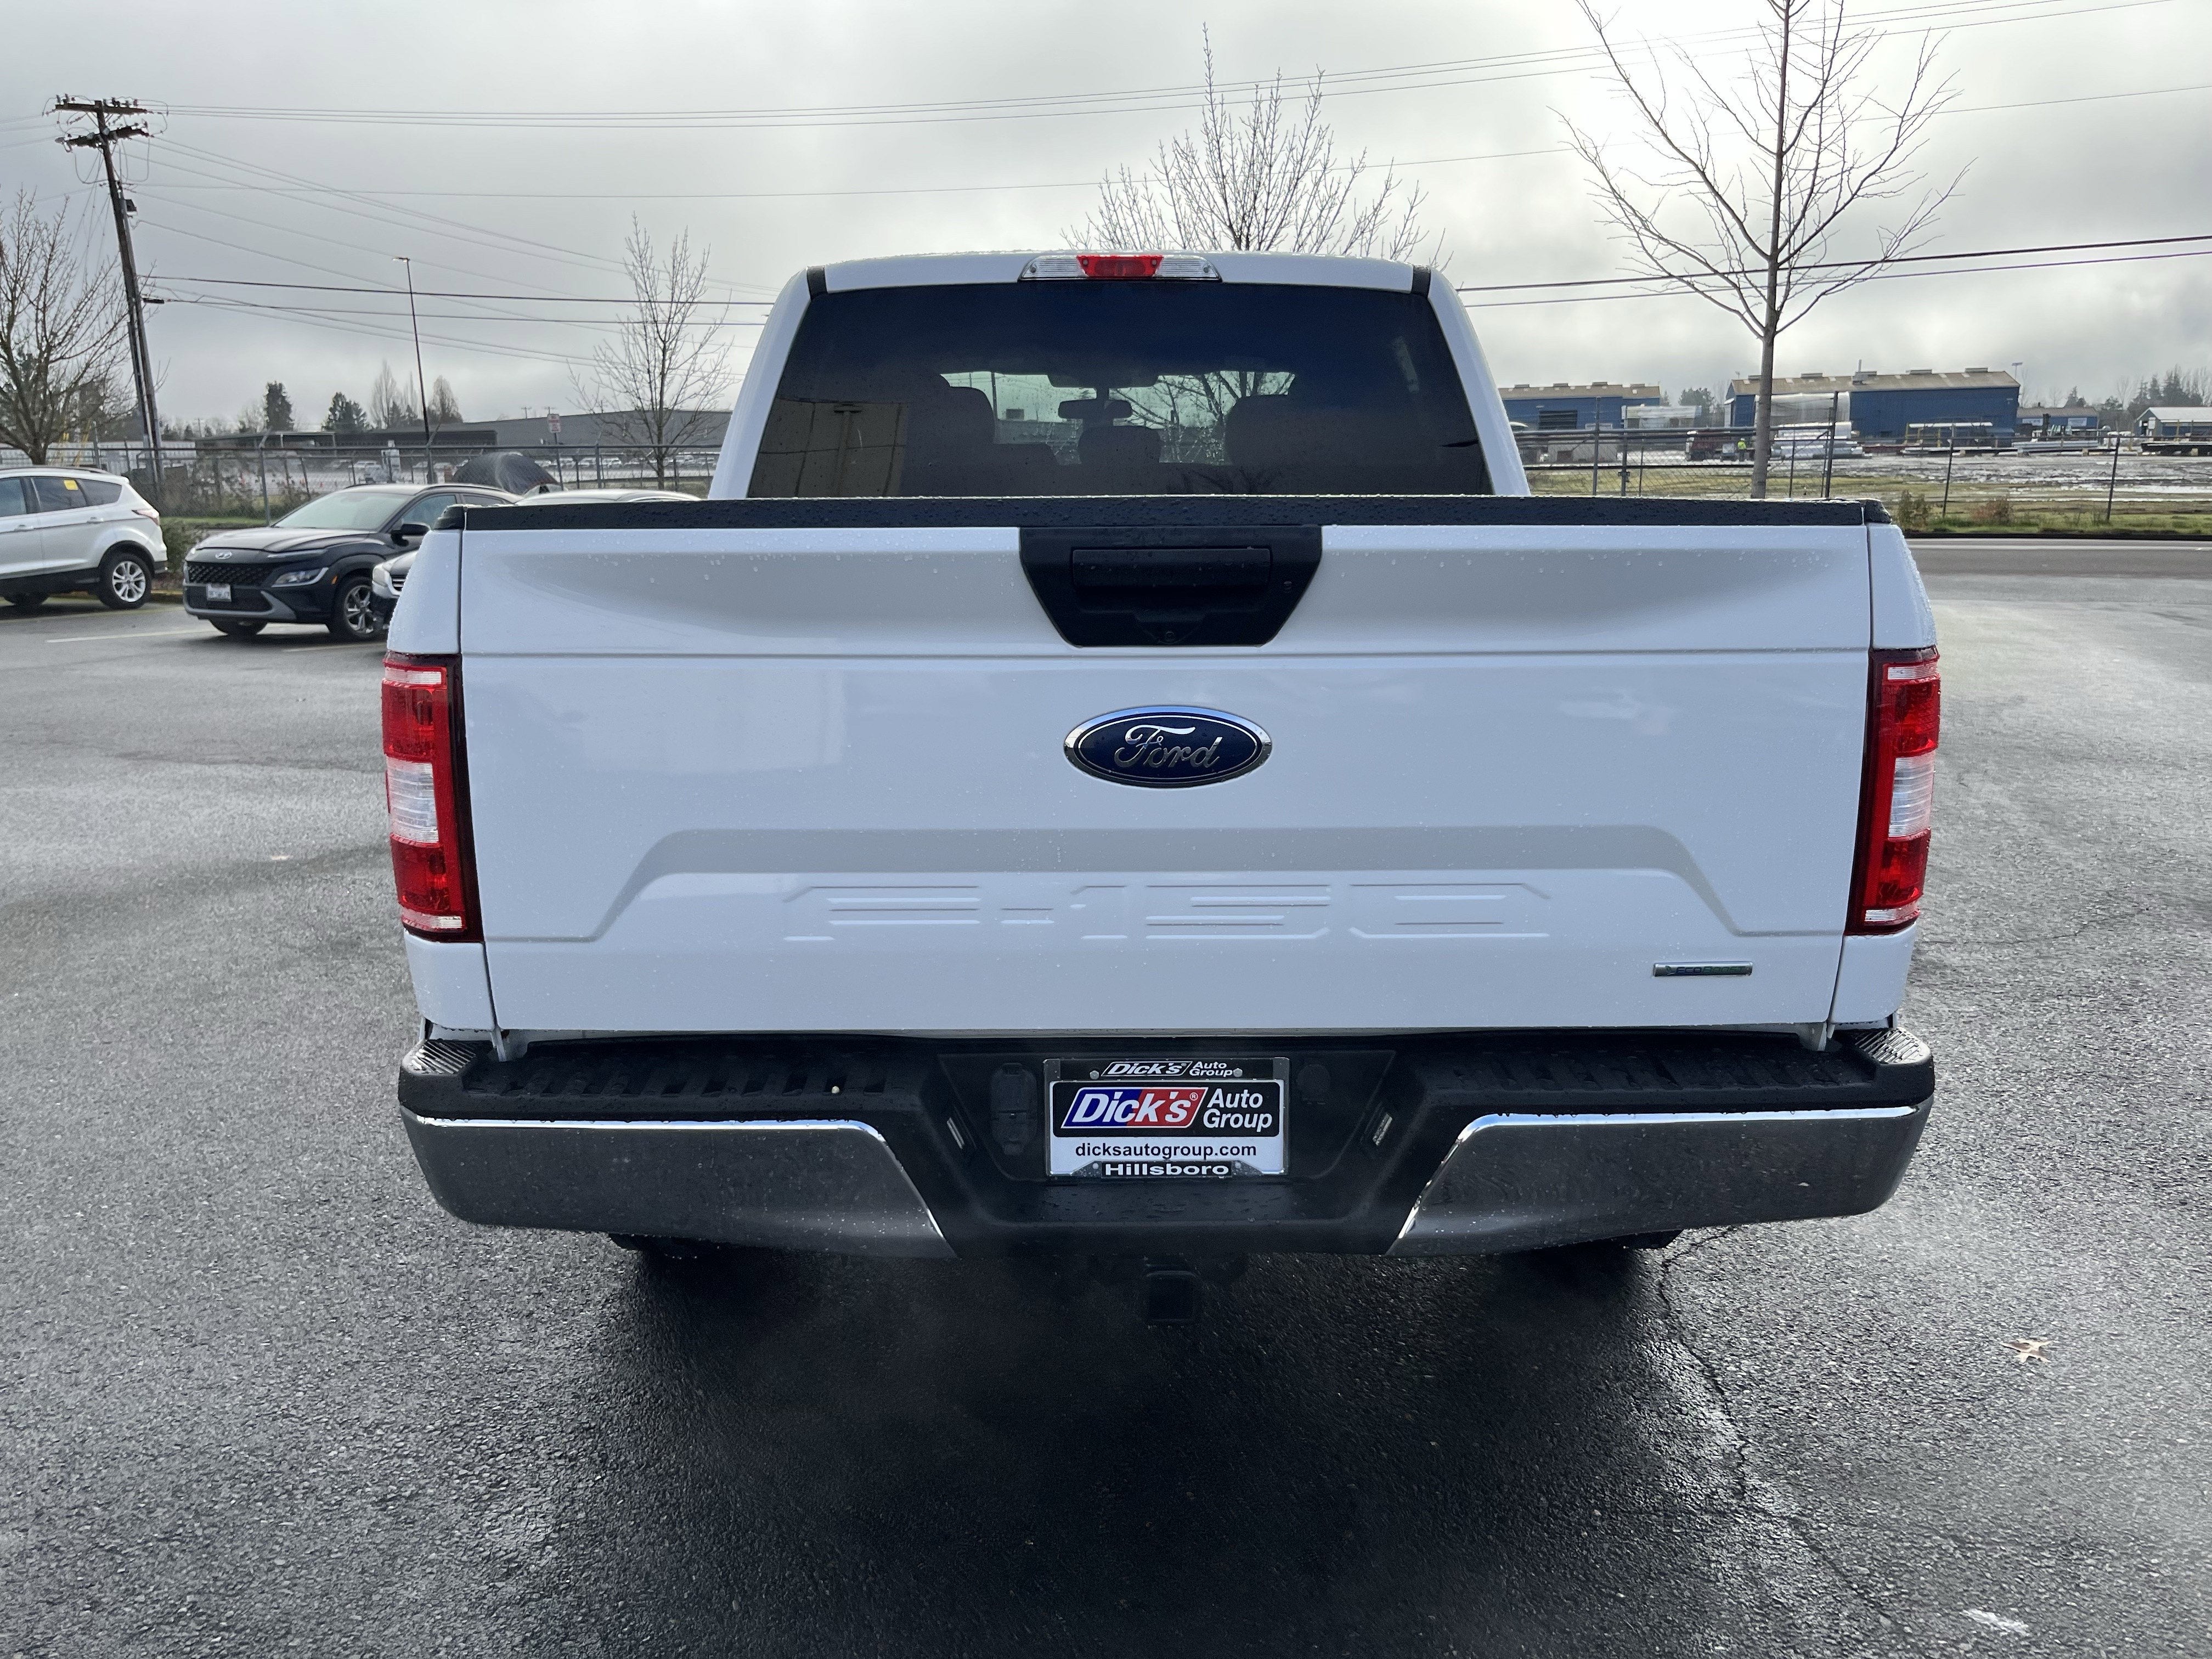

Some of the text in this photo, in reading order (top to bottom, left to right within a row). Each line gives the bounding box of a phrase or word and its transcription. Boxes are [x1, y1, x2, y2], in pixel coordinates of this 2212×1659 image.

[1114, 724, 1223, 769] Ford
[1189, 1068, 1234, 1077] Group
[1193, 1061, 1227, 1069] Auto
[1071, 1091, 1192, 1123] Dick's
[1207, 1088, 1263, 1108] Auto
[1203, 1108, 1273, 1132] Group
[1075, 1143, 1257, 1160] dicksautogroup.com
[1105, 1163, 1229, 1176] Hillsboro
